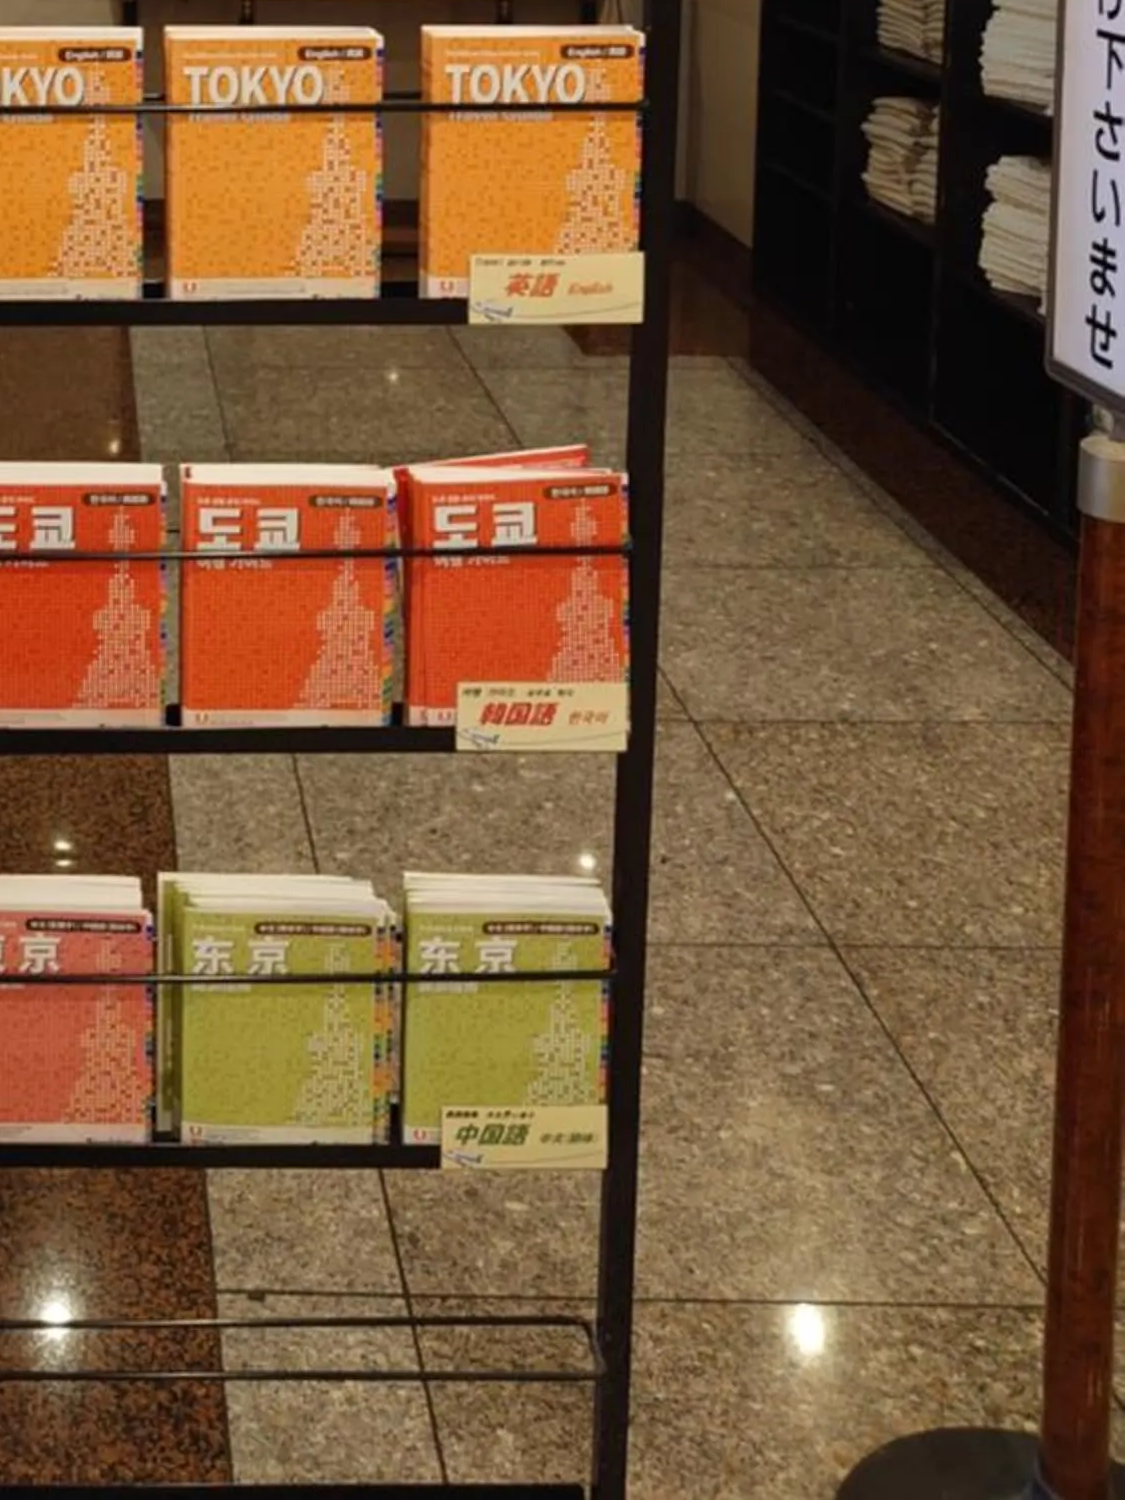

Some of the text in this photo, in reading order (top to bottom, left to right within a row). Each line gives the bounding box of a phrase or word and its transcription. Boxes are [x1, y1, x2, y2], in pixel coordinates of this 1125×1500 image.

[183, 65, 323, 106] TOKYO
[444, 63, 587, 105] TOKYO
[505, 272, 559, 298] 英語
[196, 507, 300, 551] 도쿄
[433, 502, 537, 549] 도쿄
[480, 701, 559, 726] 韓国語
[192, 935, 290, 975] 东京
[418, 935, 518, 974] 东京
[455, 1123, 531, 1146] 中国語
